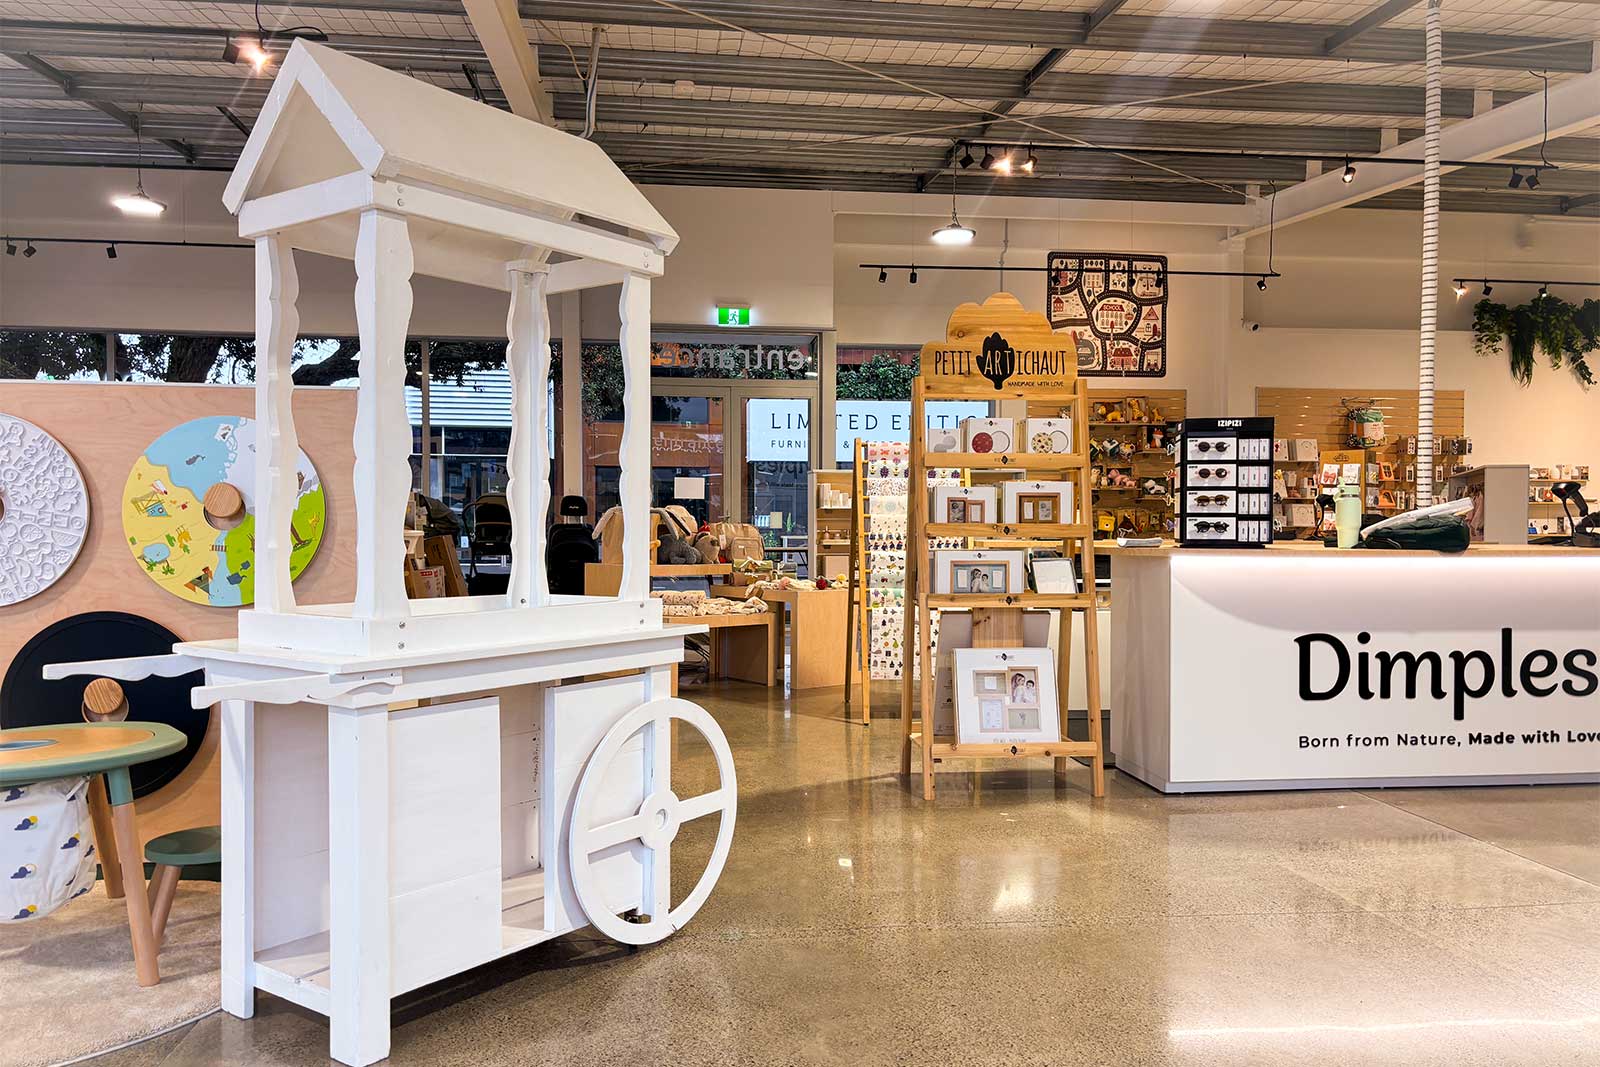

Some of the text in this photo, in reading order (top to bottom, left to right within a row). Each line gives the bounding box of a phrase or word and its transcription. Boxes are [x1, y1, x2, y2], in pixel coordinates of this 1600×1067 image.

[934, 350, 1067, 376] PETIT ARTICHAUT
[770, 413, 878, 431] LIMTED
[842, 440, 850, 449] &
[1293, 627, 1599, 721] Dimples
[1298, 735, 1340, 749] Born
[1346, 733, 1389, 747] from
[1396, 733, 1462, 747] Nature,
[1468, 731, 1515, 745] Made
[1521, 730, 1560, 743] with
